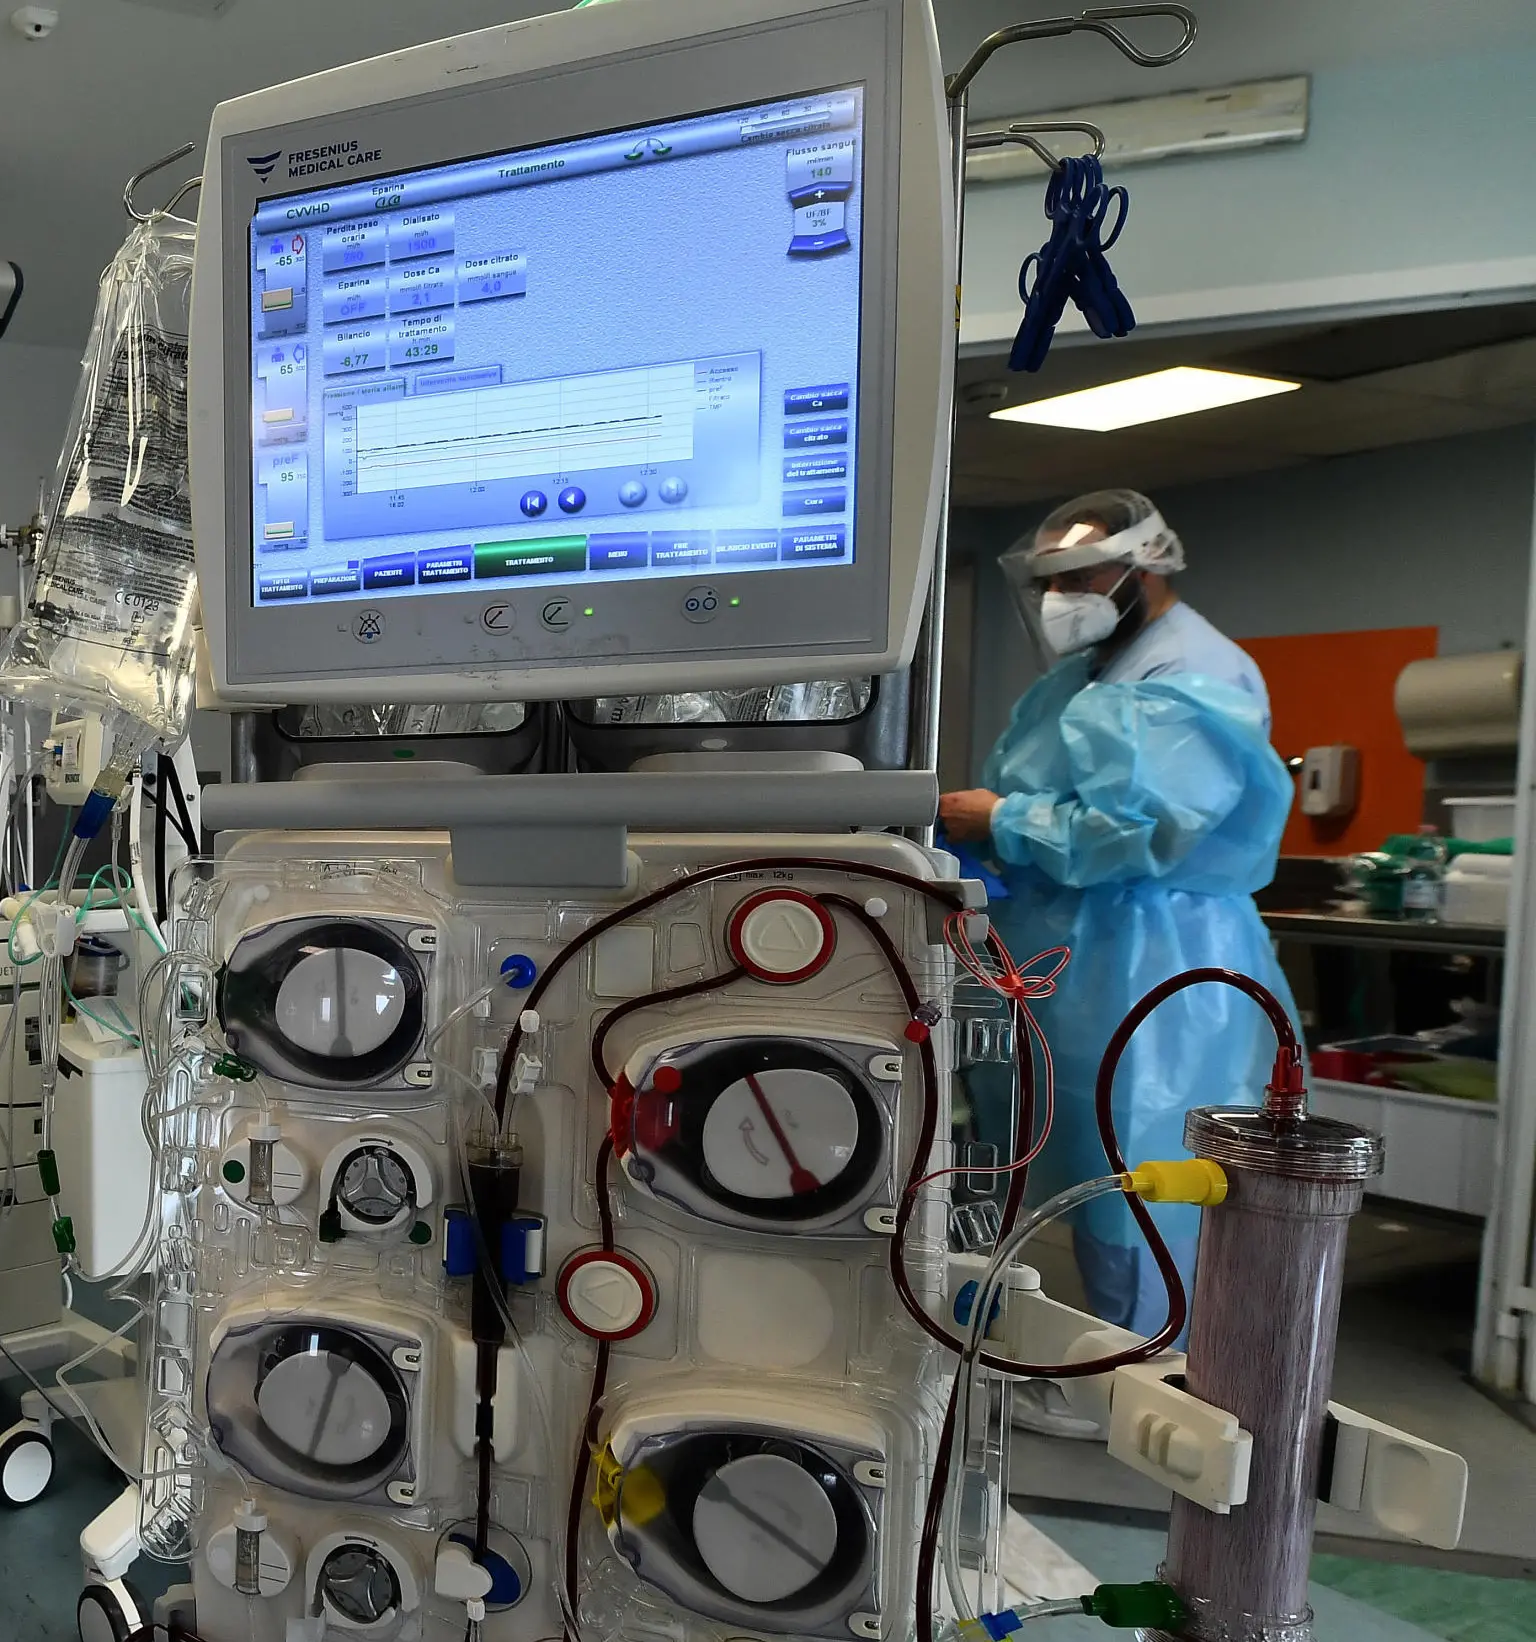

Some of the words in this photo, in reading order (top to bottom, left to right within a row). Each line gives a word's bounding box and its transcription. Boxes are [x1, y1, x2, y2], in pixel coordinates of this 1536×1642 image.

[741, 131, 773, 144] Cambio
[288, 140, 358, 165] FRESENIUS
[786, 146, 818, 157] Flusso
[821, 139, 856, 151] sangue
[288, 158, 344, 178] MEDICAL
[347, 149, 382, 166] CARE
[498, 159, 565, 178] Trattamento
[372, 183, 405, 196] Eparina
[286, 202, 330, 219] CVVHD
[402, 213, 440, 226] Dialisato
[326, 224, 356, 235] Perdita
[357, 219, 378, 231] peso
[341, 233, 366, 243] oraria
[275, 255, 293, 266] -65
[465, 259, 488, 269] Dose
[490, 253, 519, 264] citrato
[403, 270, 426, 279] Dose
[428, 266, 440, 274] Ca
[338, 279, 370, 290] Eparina
[403, 316, 432, 328] Tempo
[434, 314, 442, 323] di
[337, 331, 371, 342] Bilancio
[398, 325, 447, 339] trattamento
[405, 344, 439, 357] 43:29
[340, 354, 369, 368] -6,77
[280, 364, 293, 375] 65
[790, 393, 819, 401] Cambio
[821, 390, 843, 398] sacca
[789, 427, 818, 435] Cambio
[820, 424, 842, 432] sacca
[804, 434, 829, 442] citrato
[281, 472, 294, 482] 95
[799, 467, 845, 476] trattamento
[793, 534, 838, 543] PARAMETRI
[716, 543, 750, 553] BILANCIO
[751, 541, 777, 549] EVENTI
[804, 542, 838, 551] SISTEMA
[656, 549, 708, 559] TRATTAMENTO
[426, 560, 463, 569] PARAMETRI
[505, 556, 554, 566] TRATTAMENTO
[374, 568, 403, 577] PAZIENTE
[422, 567, 468, 577] TRATTAMENTO
[313, 575, 357, 584] PREPARAZIONE
[67, 586, 84, 595] CARE
[261, 584, 304, 593] TRATTAMENTO
[133, 594, 160, 611] 0123
[745, 871, 764, 879] max
[772, 871, 794, 880] 12kg
